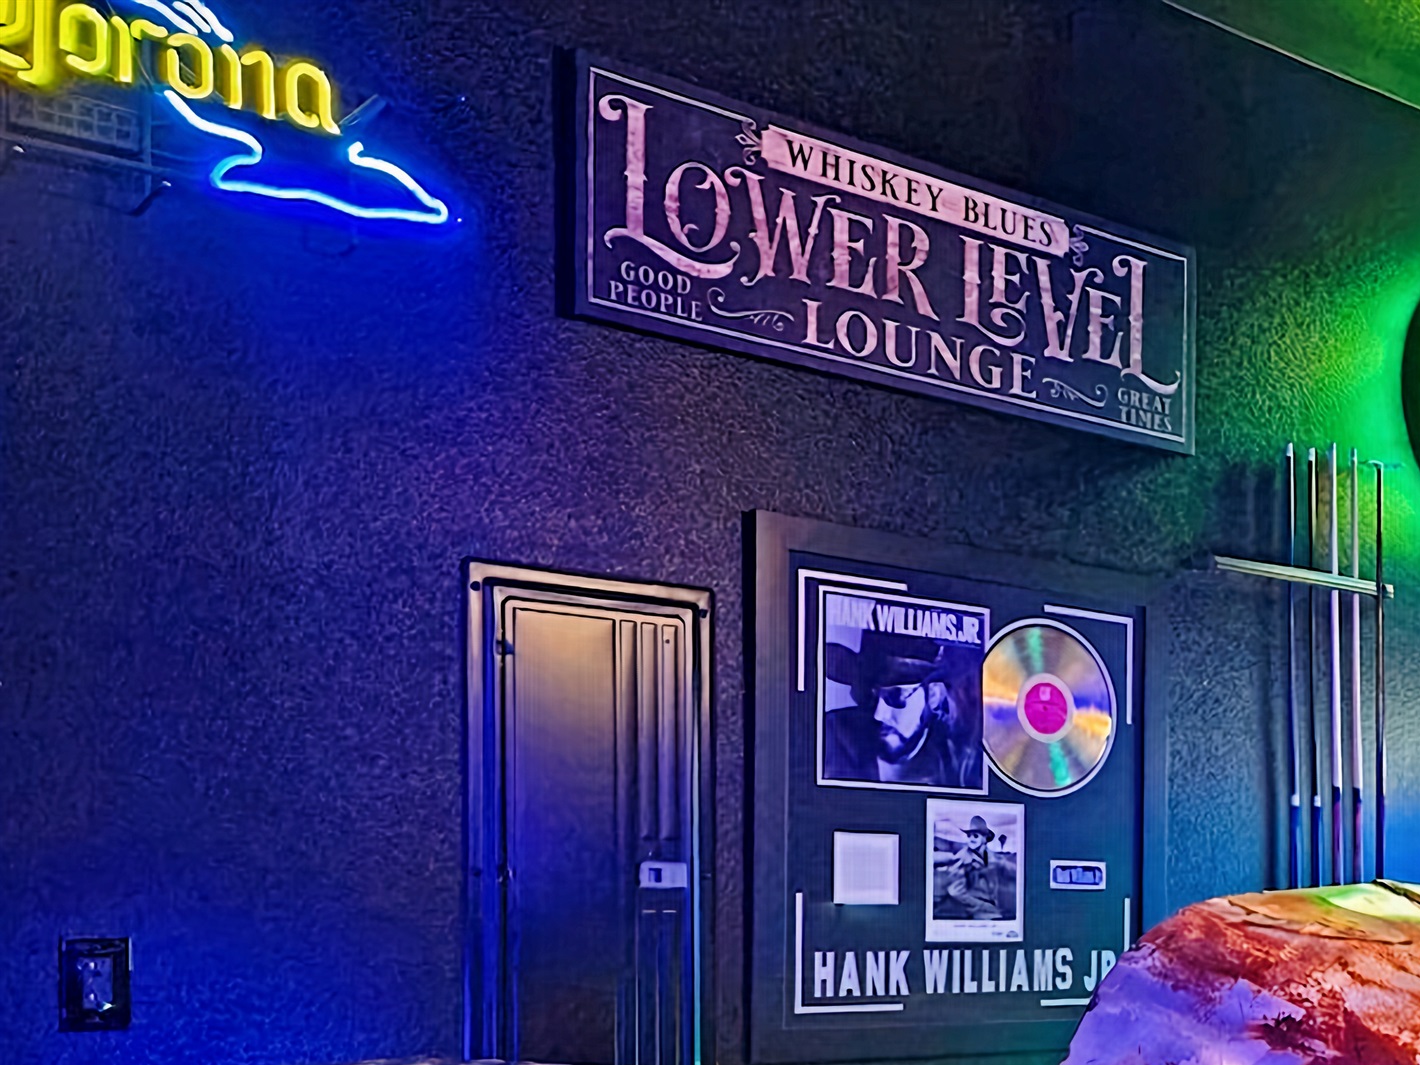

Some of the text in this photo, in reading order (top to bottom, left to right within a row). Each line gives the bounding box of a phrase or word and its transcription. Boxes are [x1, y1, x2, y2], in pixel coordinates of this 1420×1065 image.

[785, 139, 1053, 247] WHISKEY BLUES
[598, 94, 1181, 395] LOWER LEVEL
[620, 261, 691, 294] GOOD
[609, 280, 703, 322] PEOPLE
[802, 298, 1038, 400] LOUNGE
[1117, 387, 1172, 415] GREAT
[1118, 405, 1172, 432] TIMES
[814, 951, 911, 997] HANK
[923, 948, 1074, 994] WILLIAMS
